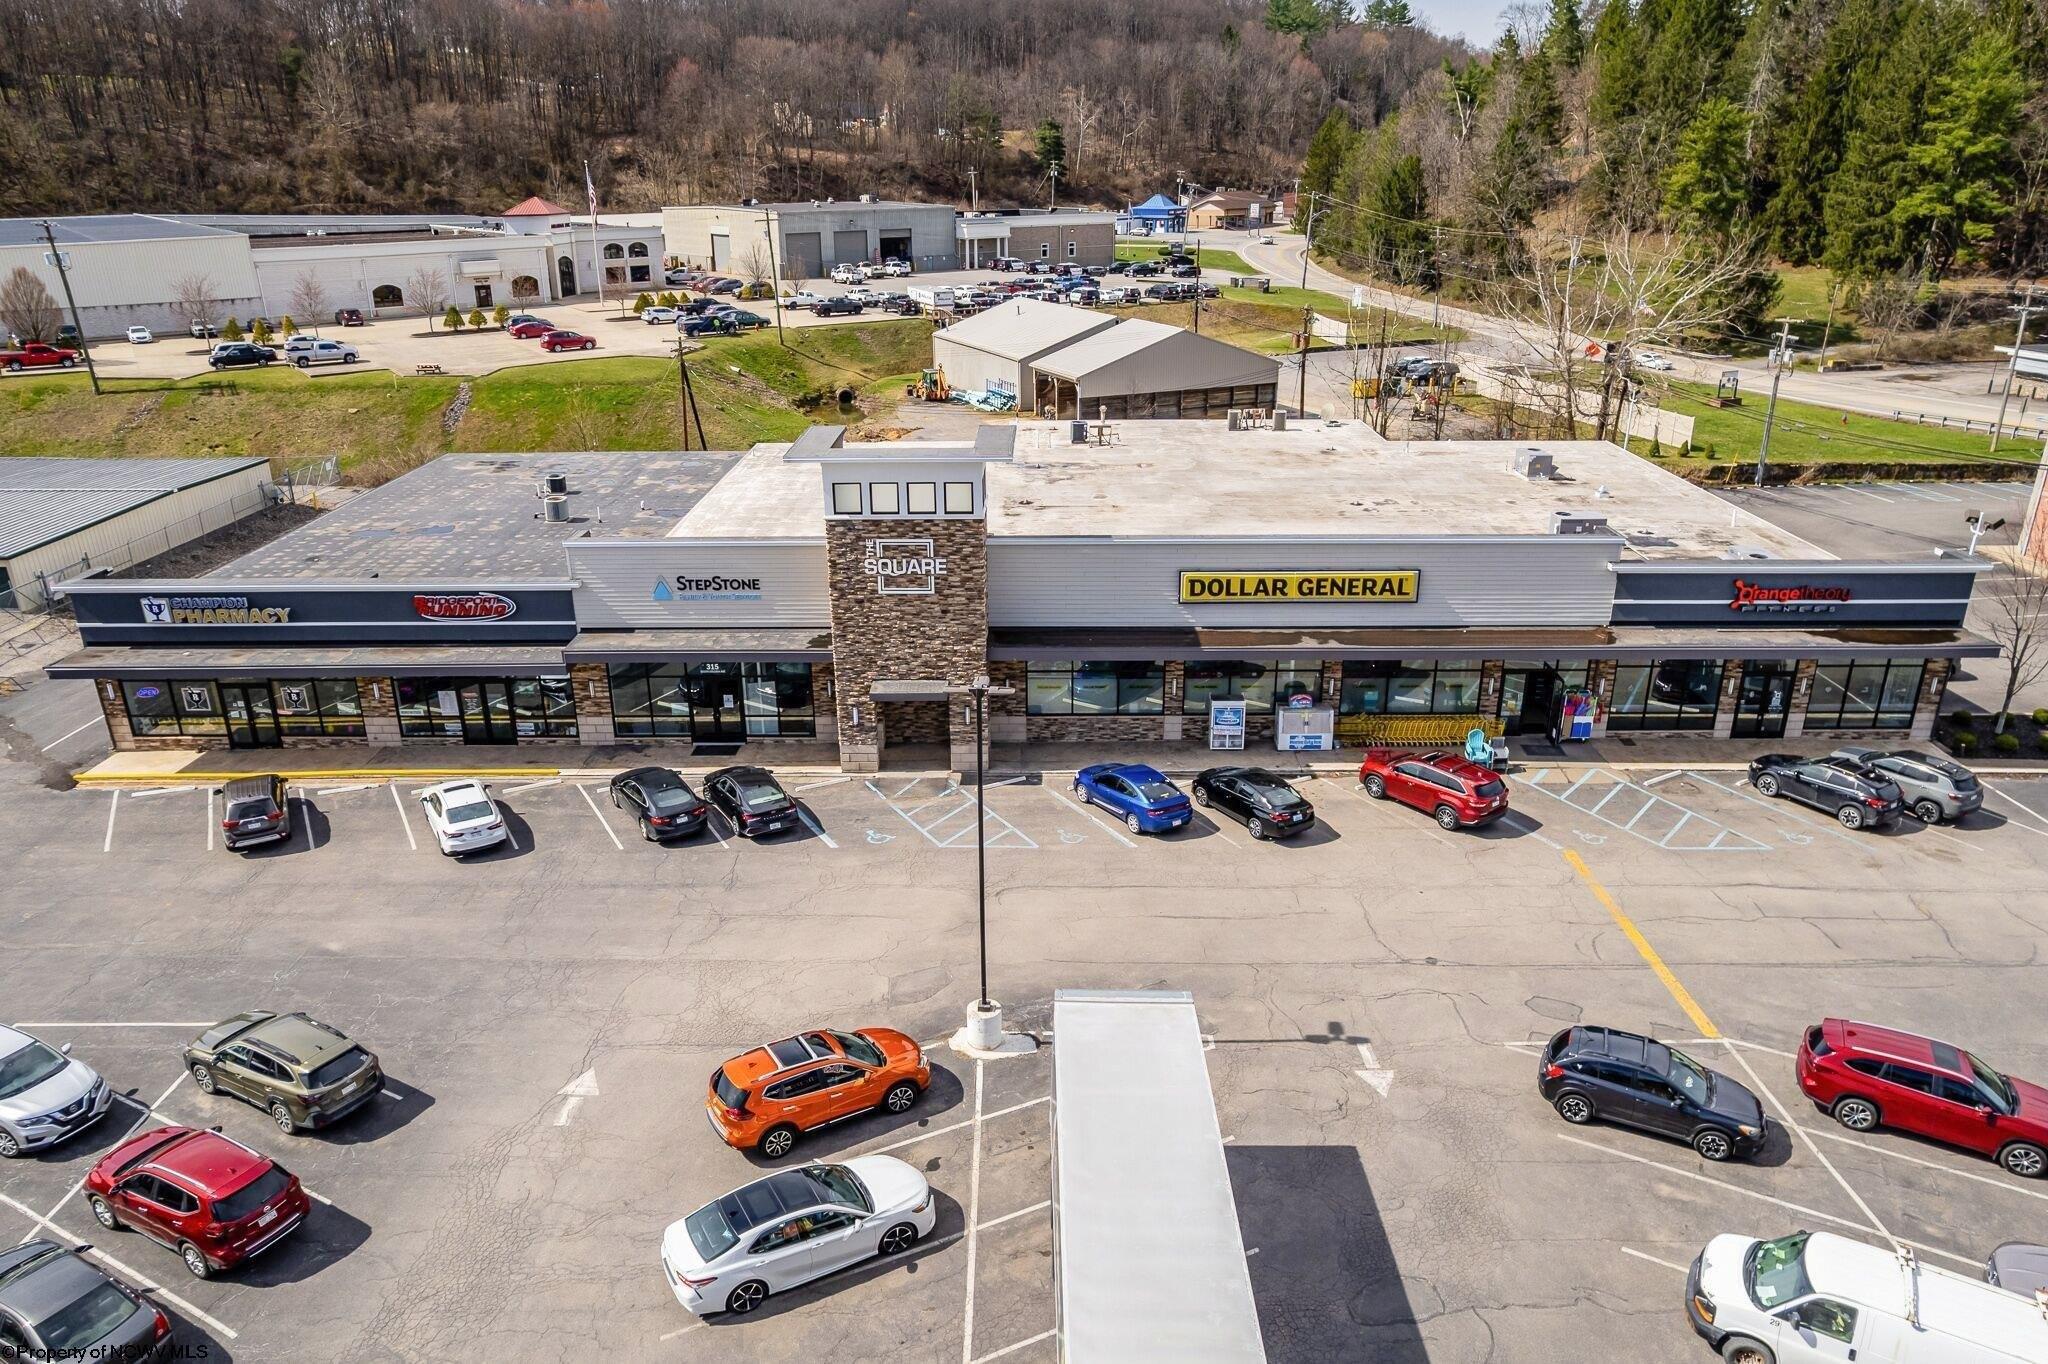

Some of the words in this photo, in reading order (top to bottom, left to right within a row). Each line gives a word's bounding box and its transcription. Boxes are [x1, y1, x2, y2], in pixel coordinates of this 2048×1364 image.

[865, 538, 875, 558] THE
[864, 558, 947, 576] SQUARE
[1188, 578, 1289, 597] DOLLAR
[1297, 577, 1410, 597] GENERAL
[170, 597, 248, 609] CHAMPION
[416, 603, 508, 616] RUNNING
[172, 607, 291, 623] PHARMACY
[1770, 1319, 1780, 1327] 29
